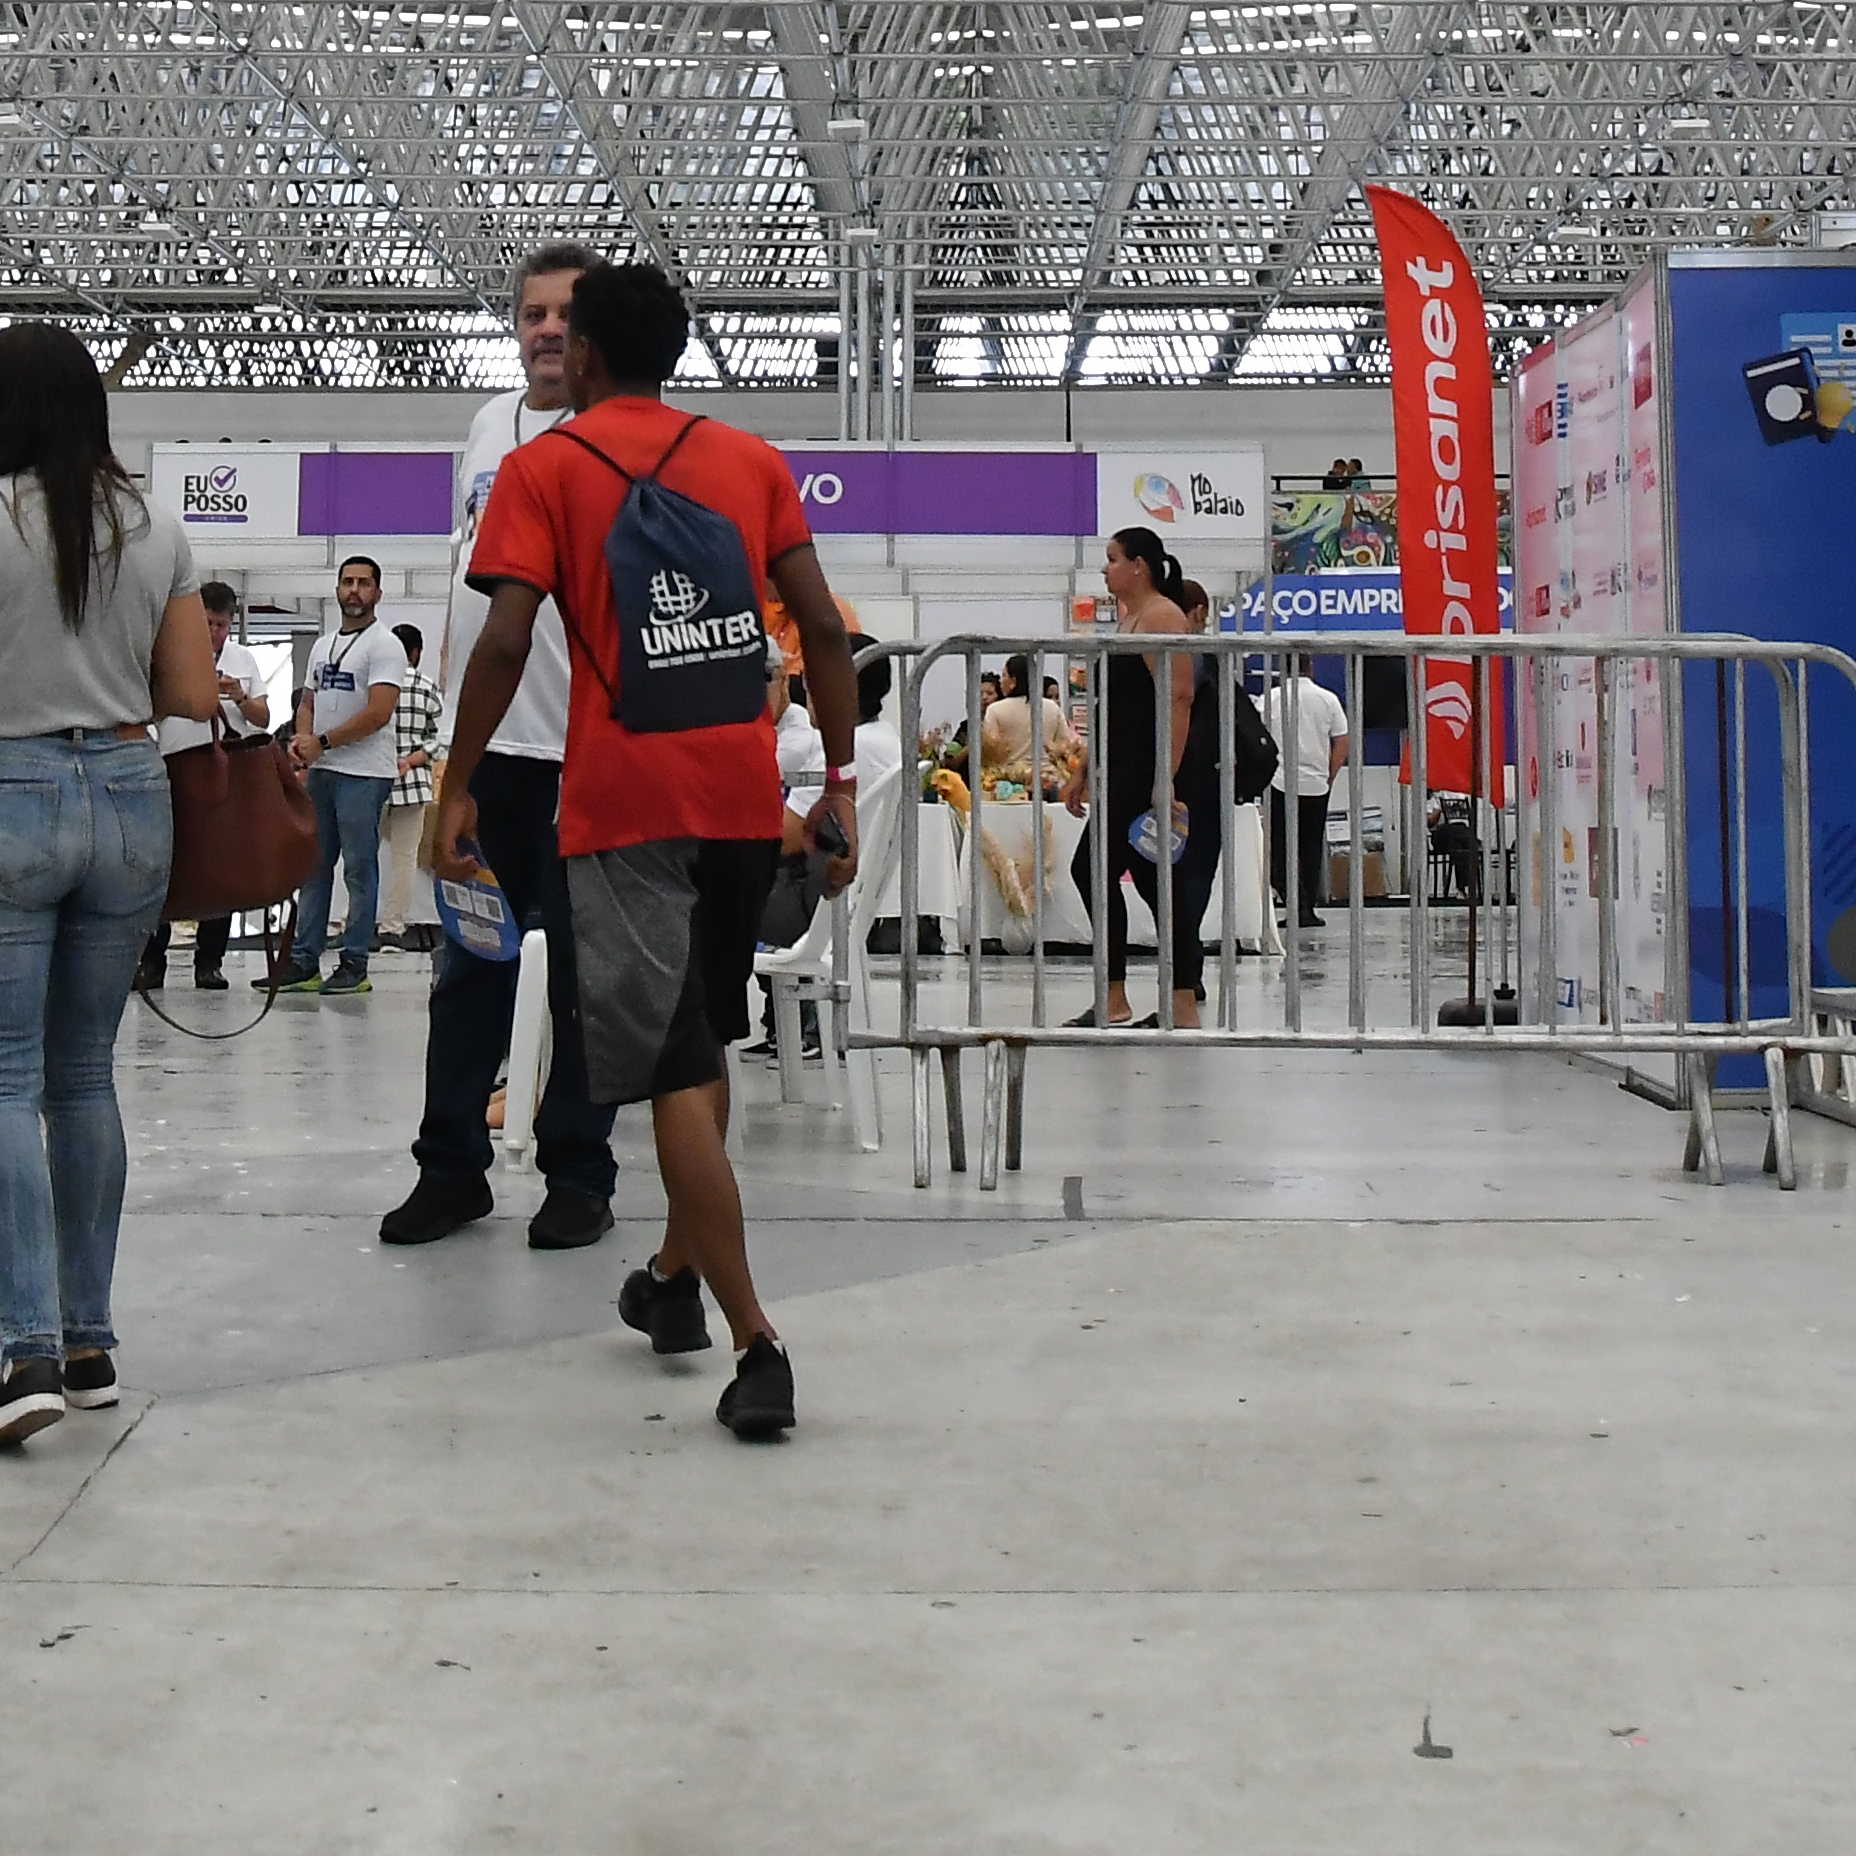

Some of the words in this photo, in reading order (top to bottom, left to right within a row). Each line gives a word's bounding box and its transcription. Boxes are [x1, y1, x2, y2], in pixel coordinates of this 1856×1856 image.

[184, 475, 208, 493] EU
[183, 494, 248, 513] POSSO
[1192, 491, 1245, 517] balaio
[640, 609, 761, 656] UNINTER
